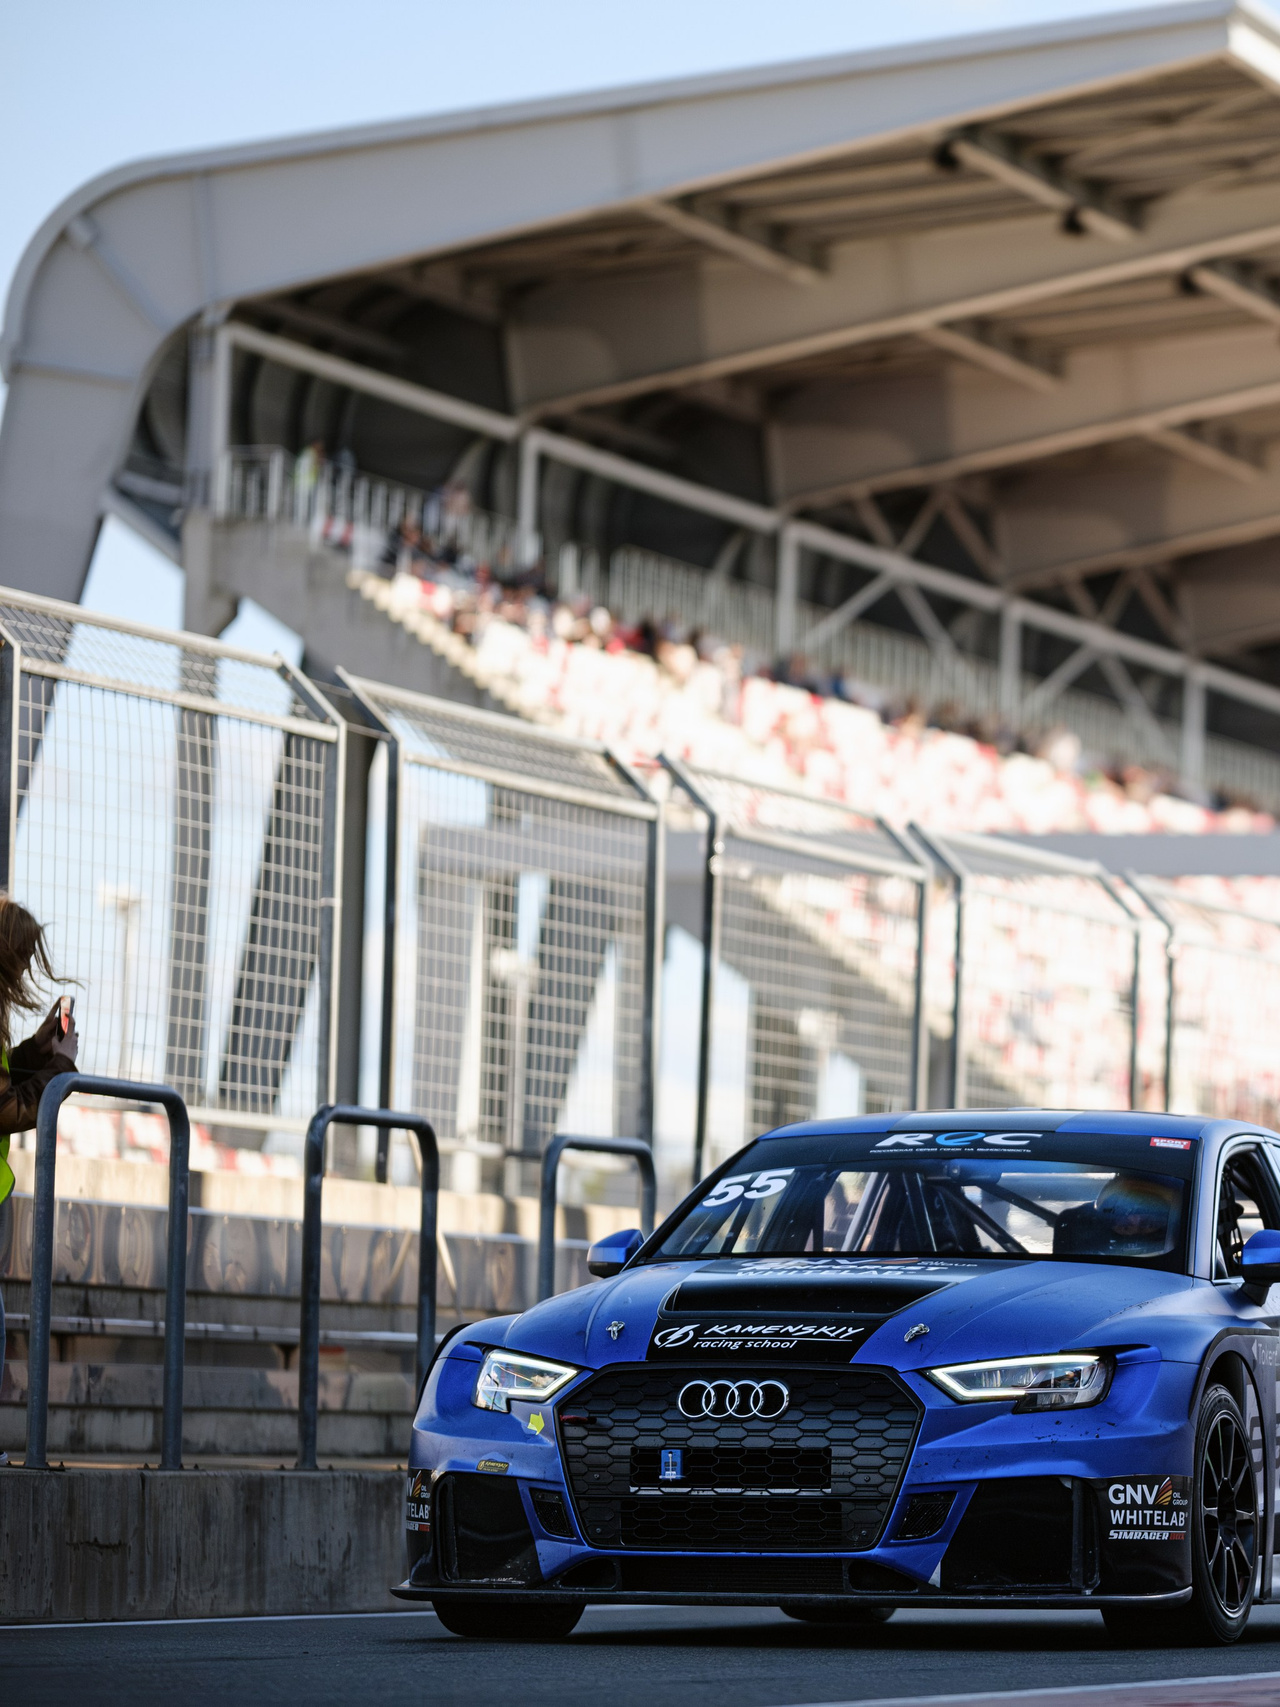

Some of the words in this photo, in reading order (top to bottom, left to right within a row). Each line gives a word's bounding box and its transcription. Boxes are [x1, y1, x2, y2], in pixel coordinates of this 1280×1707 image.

[702, 1168, 795, 1207] 55
[703, 1323, 865, 1338] KAMENSKIY
[693, 1339, 743, 1350] racing
[744, 1339, 797, 1349] school
[1108, 1483, 1159, 1505] GNV
[1110, 1509, 1185, 1527] WHITELAB
